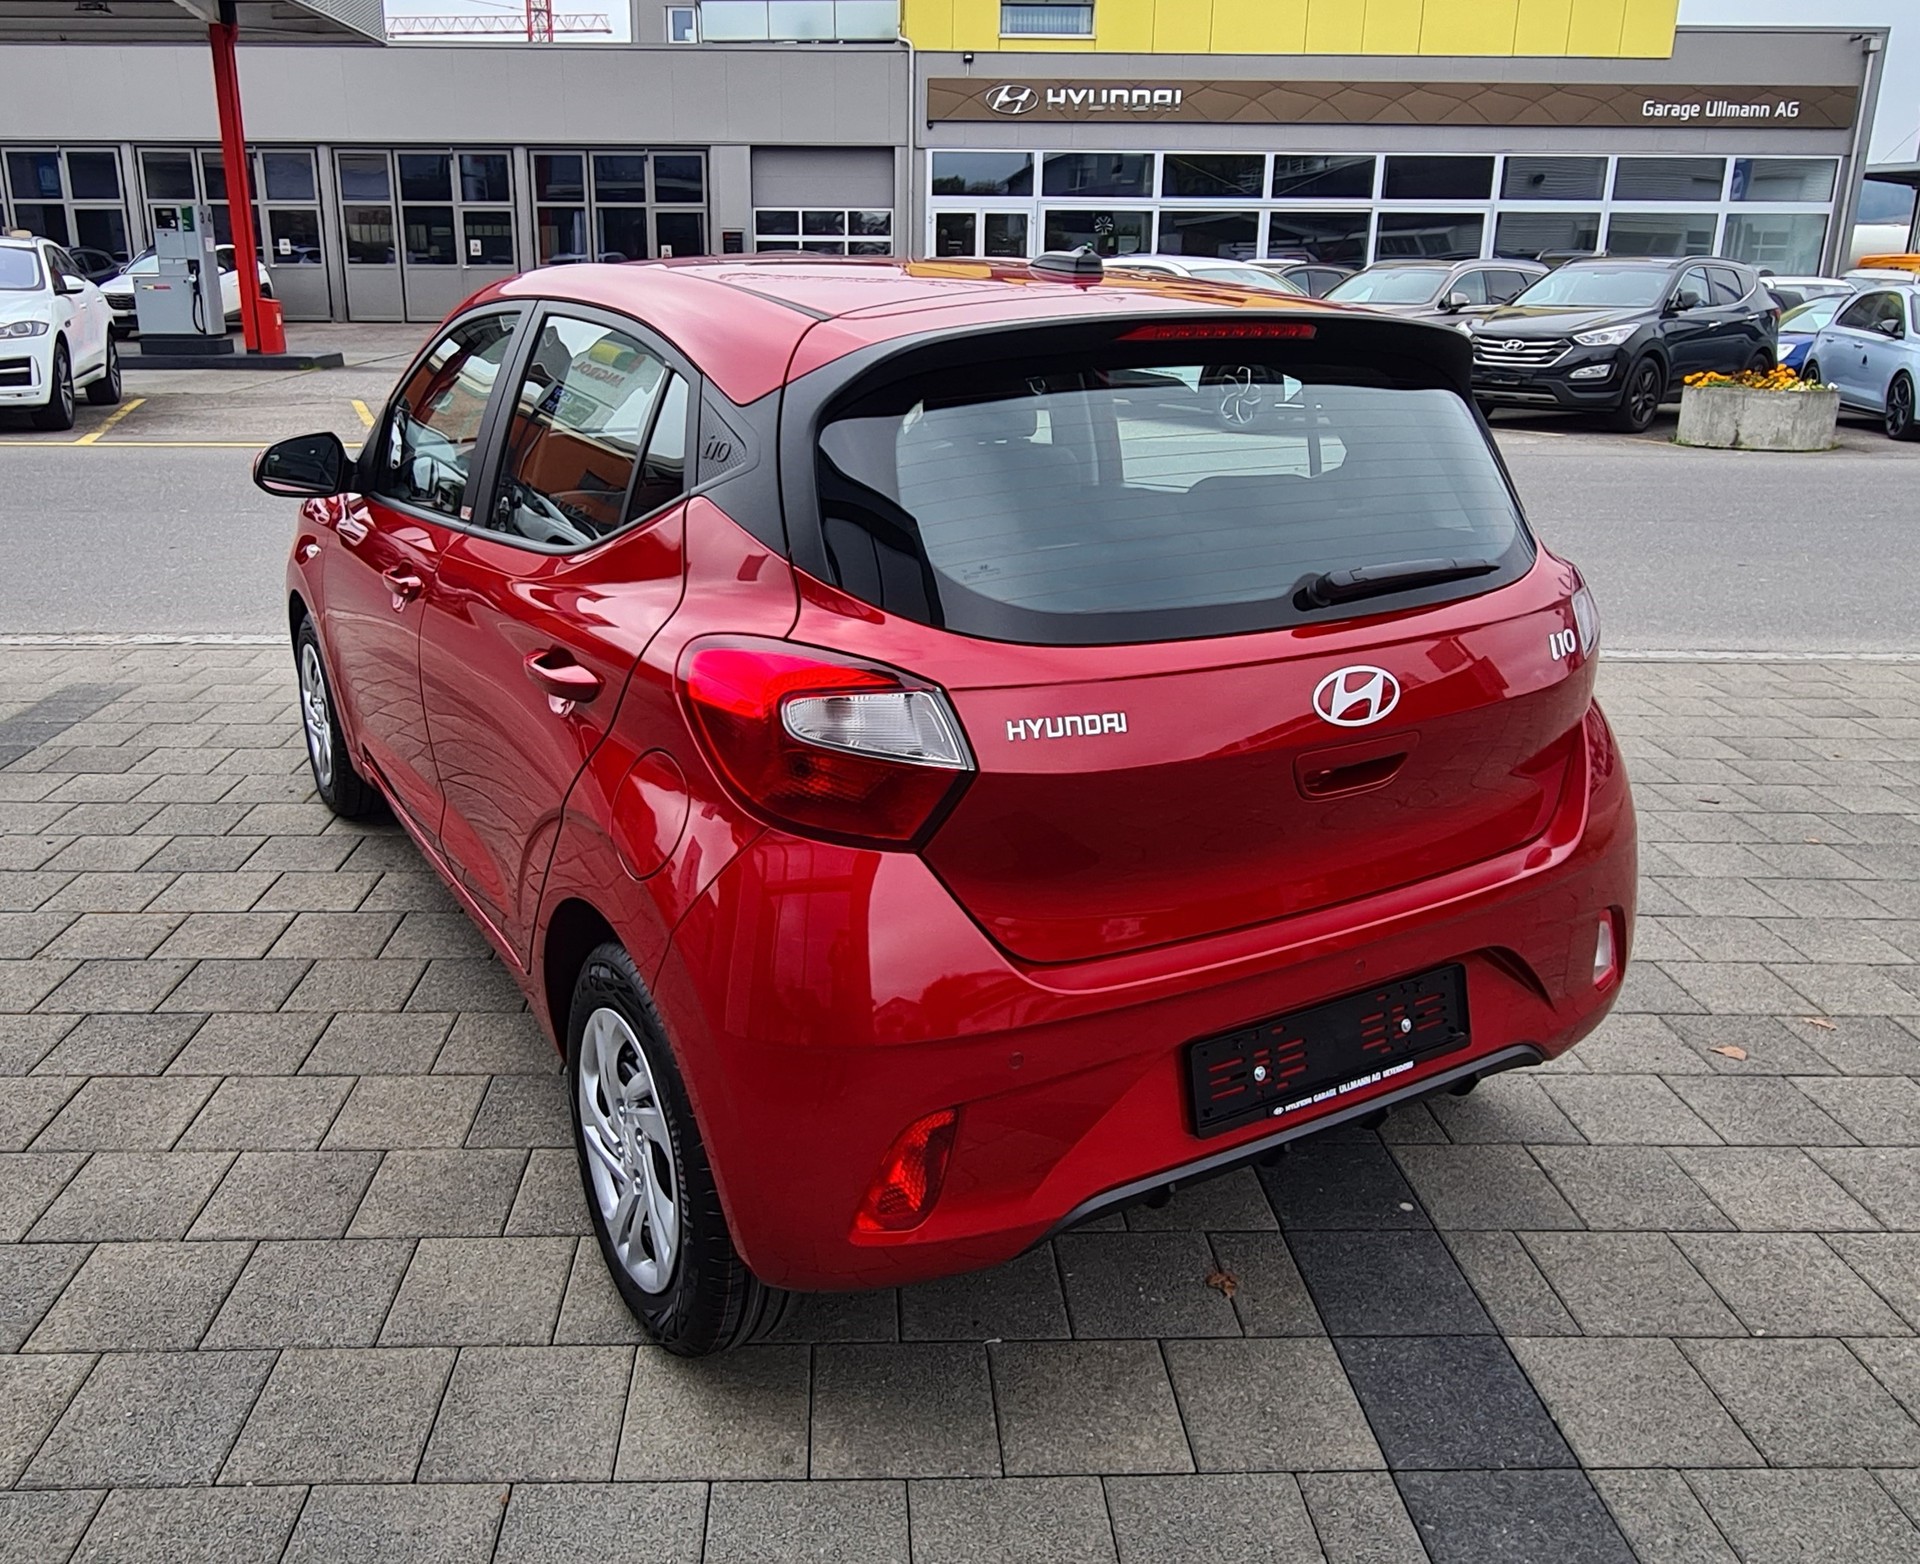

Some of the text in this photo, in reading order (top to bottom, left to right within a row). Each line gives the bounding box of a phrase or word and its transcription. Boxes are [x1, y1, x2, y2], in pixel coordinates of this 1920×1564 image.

[1047, 88, 1182, 112] HYUNDAI
[1642, 100, 1800, 121] Garage Ullmann AG
[702, 435, 731, 463] i10
[1006, 712, 1128, 741] HYUNDAI
[1338, 1075, 1371, 1094] ULLMANN
[1371, 1072, 1382, 1083] AG
